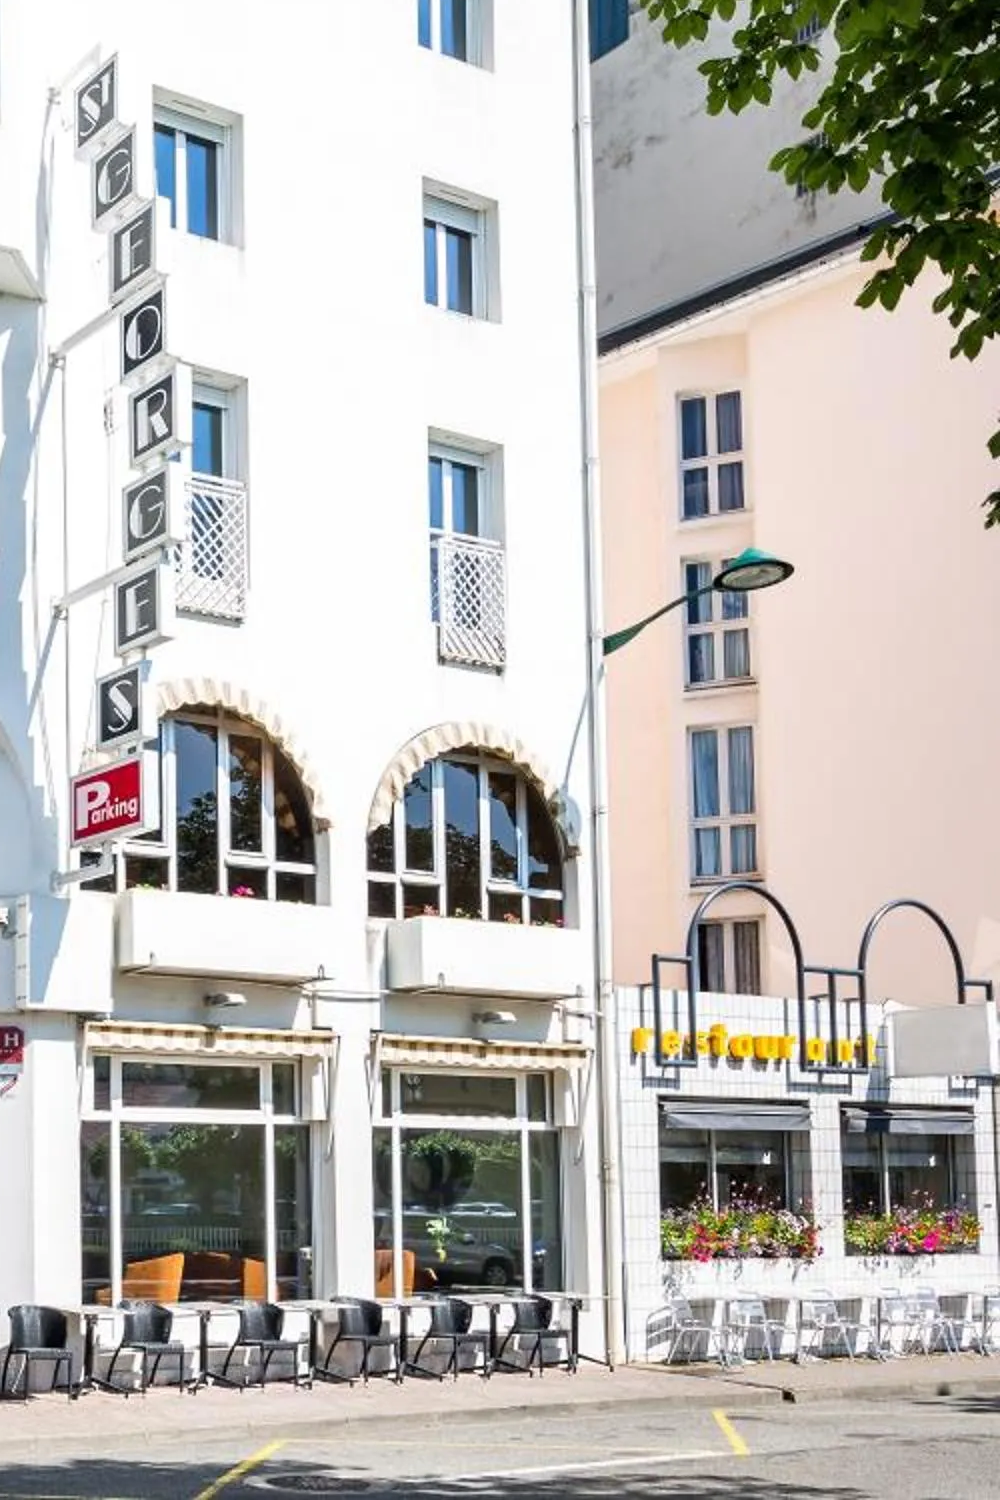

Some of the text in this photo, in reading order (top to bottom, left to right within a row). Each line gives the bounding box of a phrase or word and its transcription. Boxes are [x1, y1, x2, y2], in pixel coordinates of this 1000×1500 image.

[98, 148, 168, 733] GEORGES
[76, 780, 138, 831] Parking
[4, 1033, 19, 1047] H
